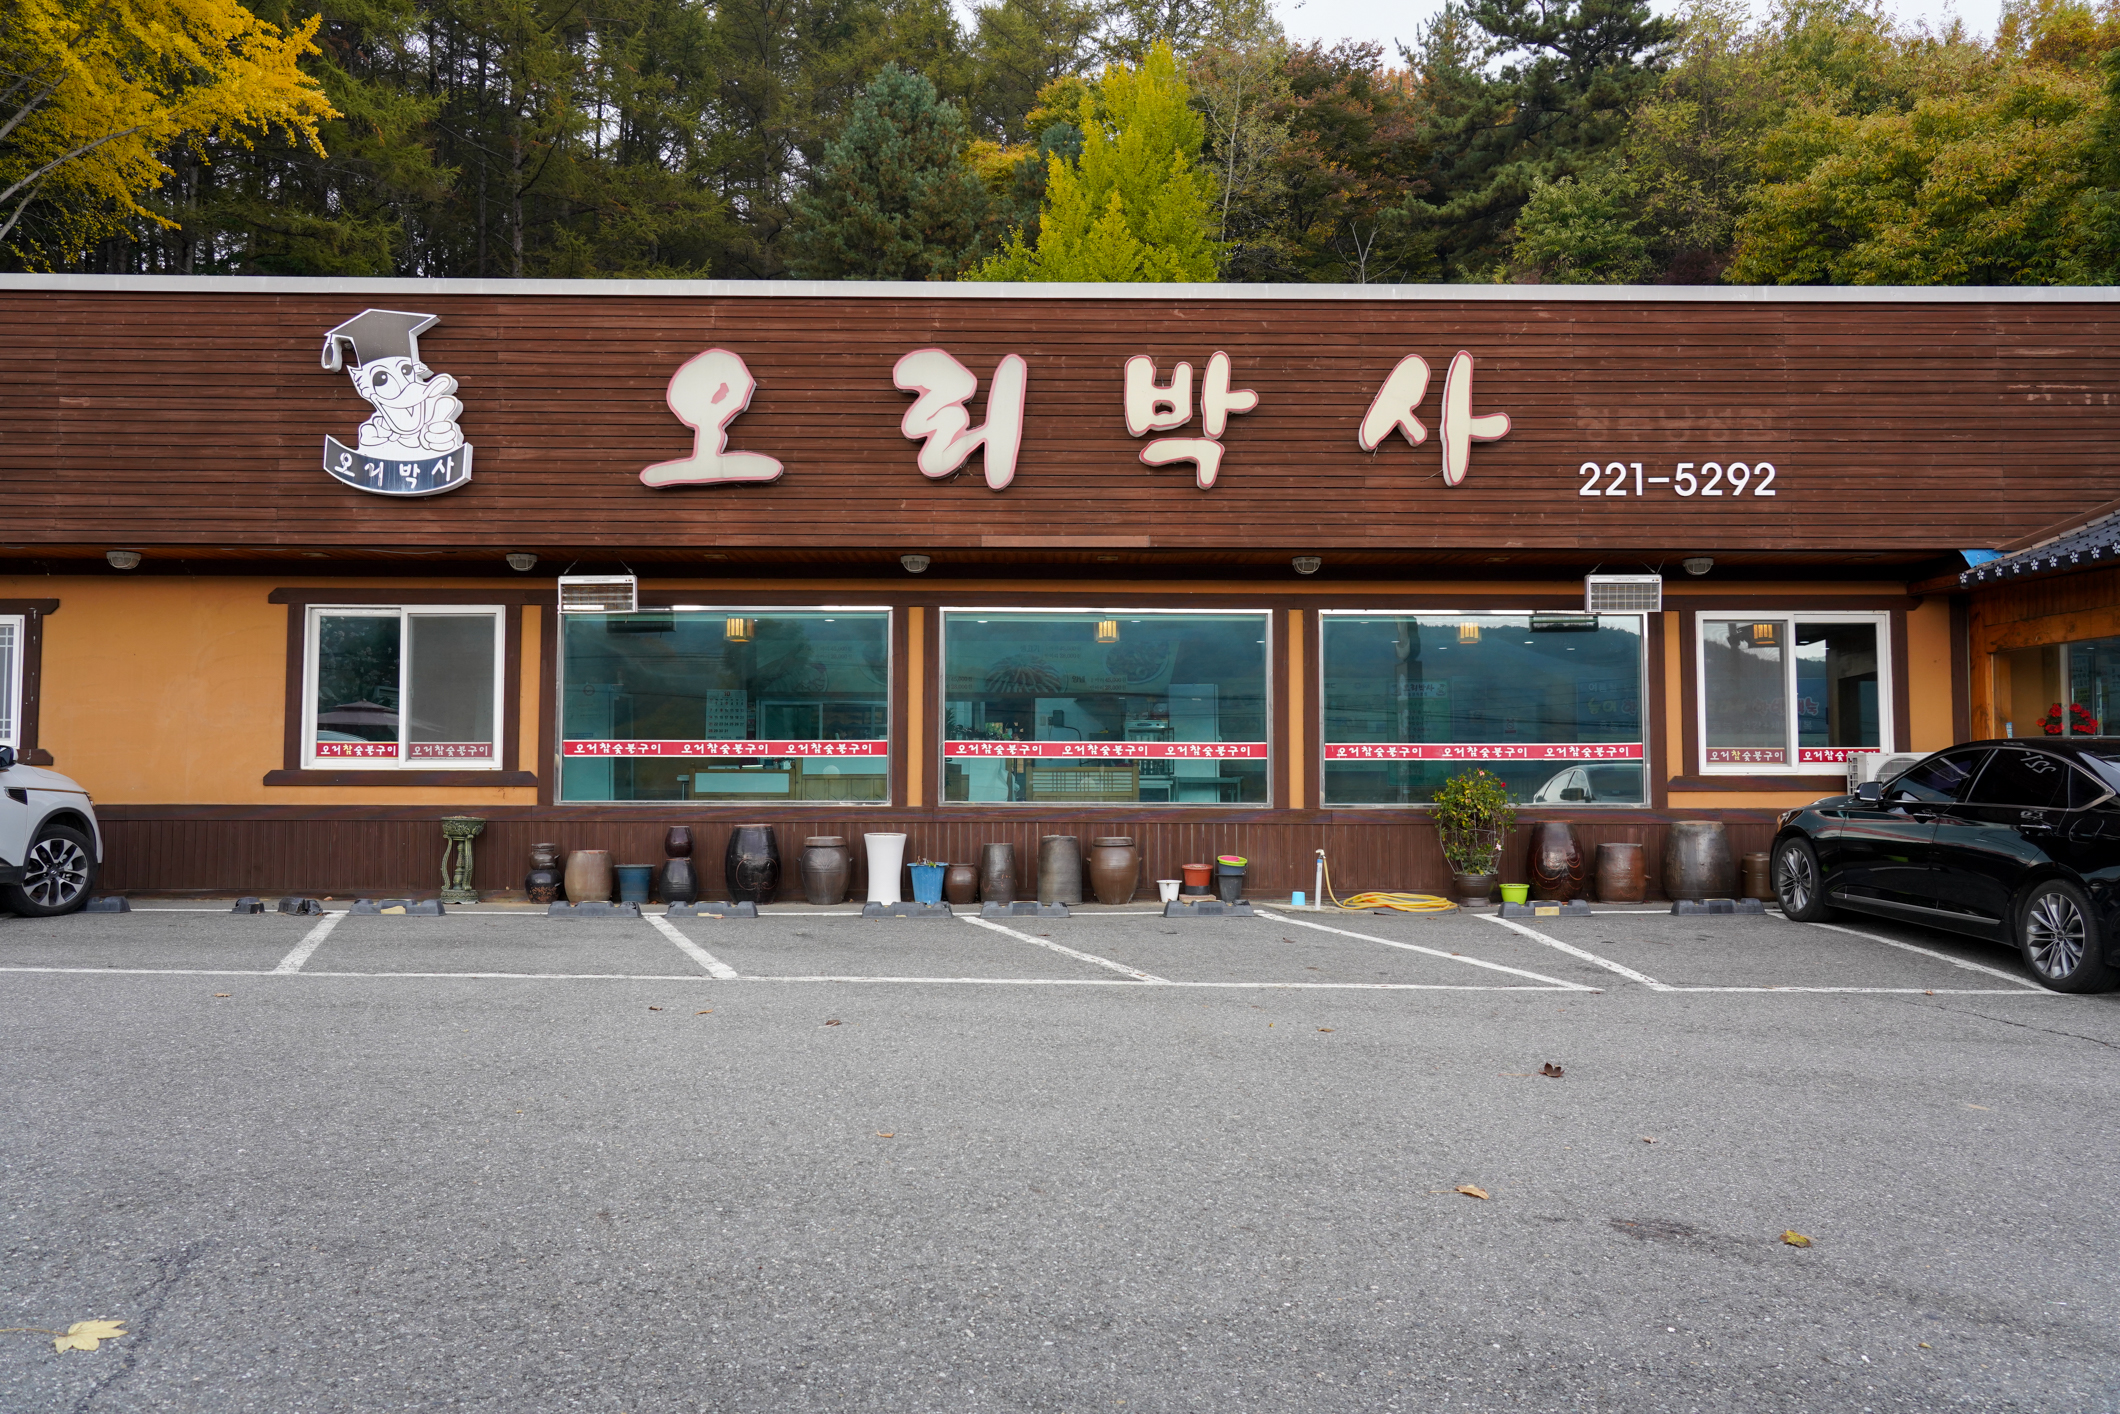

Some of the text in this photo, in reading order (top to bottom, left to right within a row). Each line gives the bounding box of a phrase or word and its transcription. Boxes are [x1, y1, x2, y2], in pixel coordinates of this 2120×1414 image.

[639, 348, 1512, 489] 오리박사
[334, 452, 454, 489] 오리박사
[1579, 461, 1776, 497] 221-5292
[321, 744, 397, 757] 오리참숯불구이
[574, 743, 872, 756] 오리참숯불구이 오리참숯불구이 오리참숯불구이
[956, 744, 1251, 757] 오리참숯불구이 오리참숯불구이 오리참숯불구이
[1336, 746, 1630, 758] 오리참숯불구이 오리참숯불구이 오리참숯불구이
[1803, 750, 1876, 762] 오리참숯
